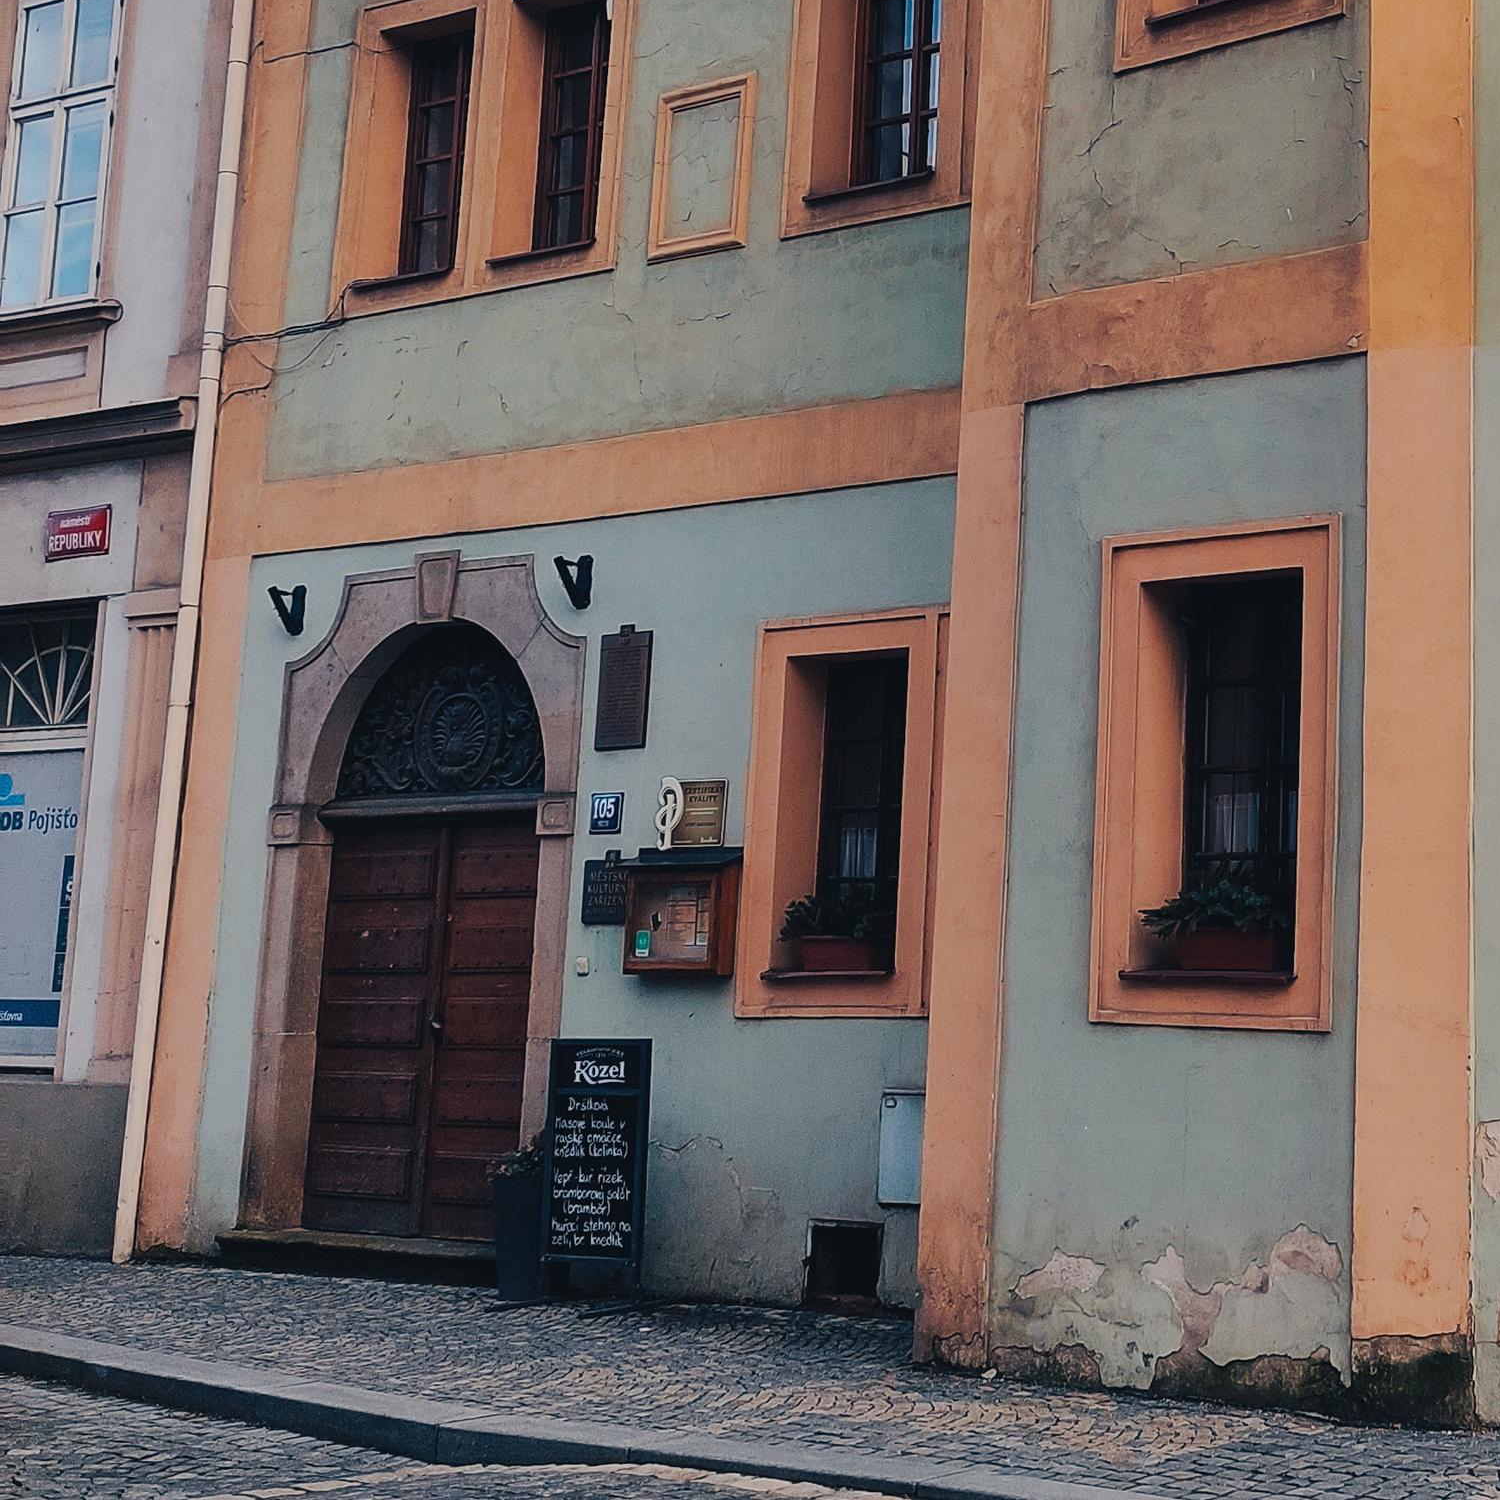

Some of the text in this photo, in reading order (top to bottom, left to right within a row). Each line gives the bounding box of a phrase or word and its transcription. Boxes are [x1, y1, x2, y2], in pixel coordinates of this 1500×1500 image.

[48, 530, 102, 552] REPUBLIKY
[592, 798, 616, 819] 105
[587, 883, 626, 894] KULTURN
[587, 895, 625, 907] ZAŘÍZEN
[573, 1060, 625, 1084] Kozel
[591, 1113, 615, 1129] koule
[583, 1217, 616, 1232] stehno
[619, 1222, 631, 1232] na
